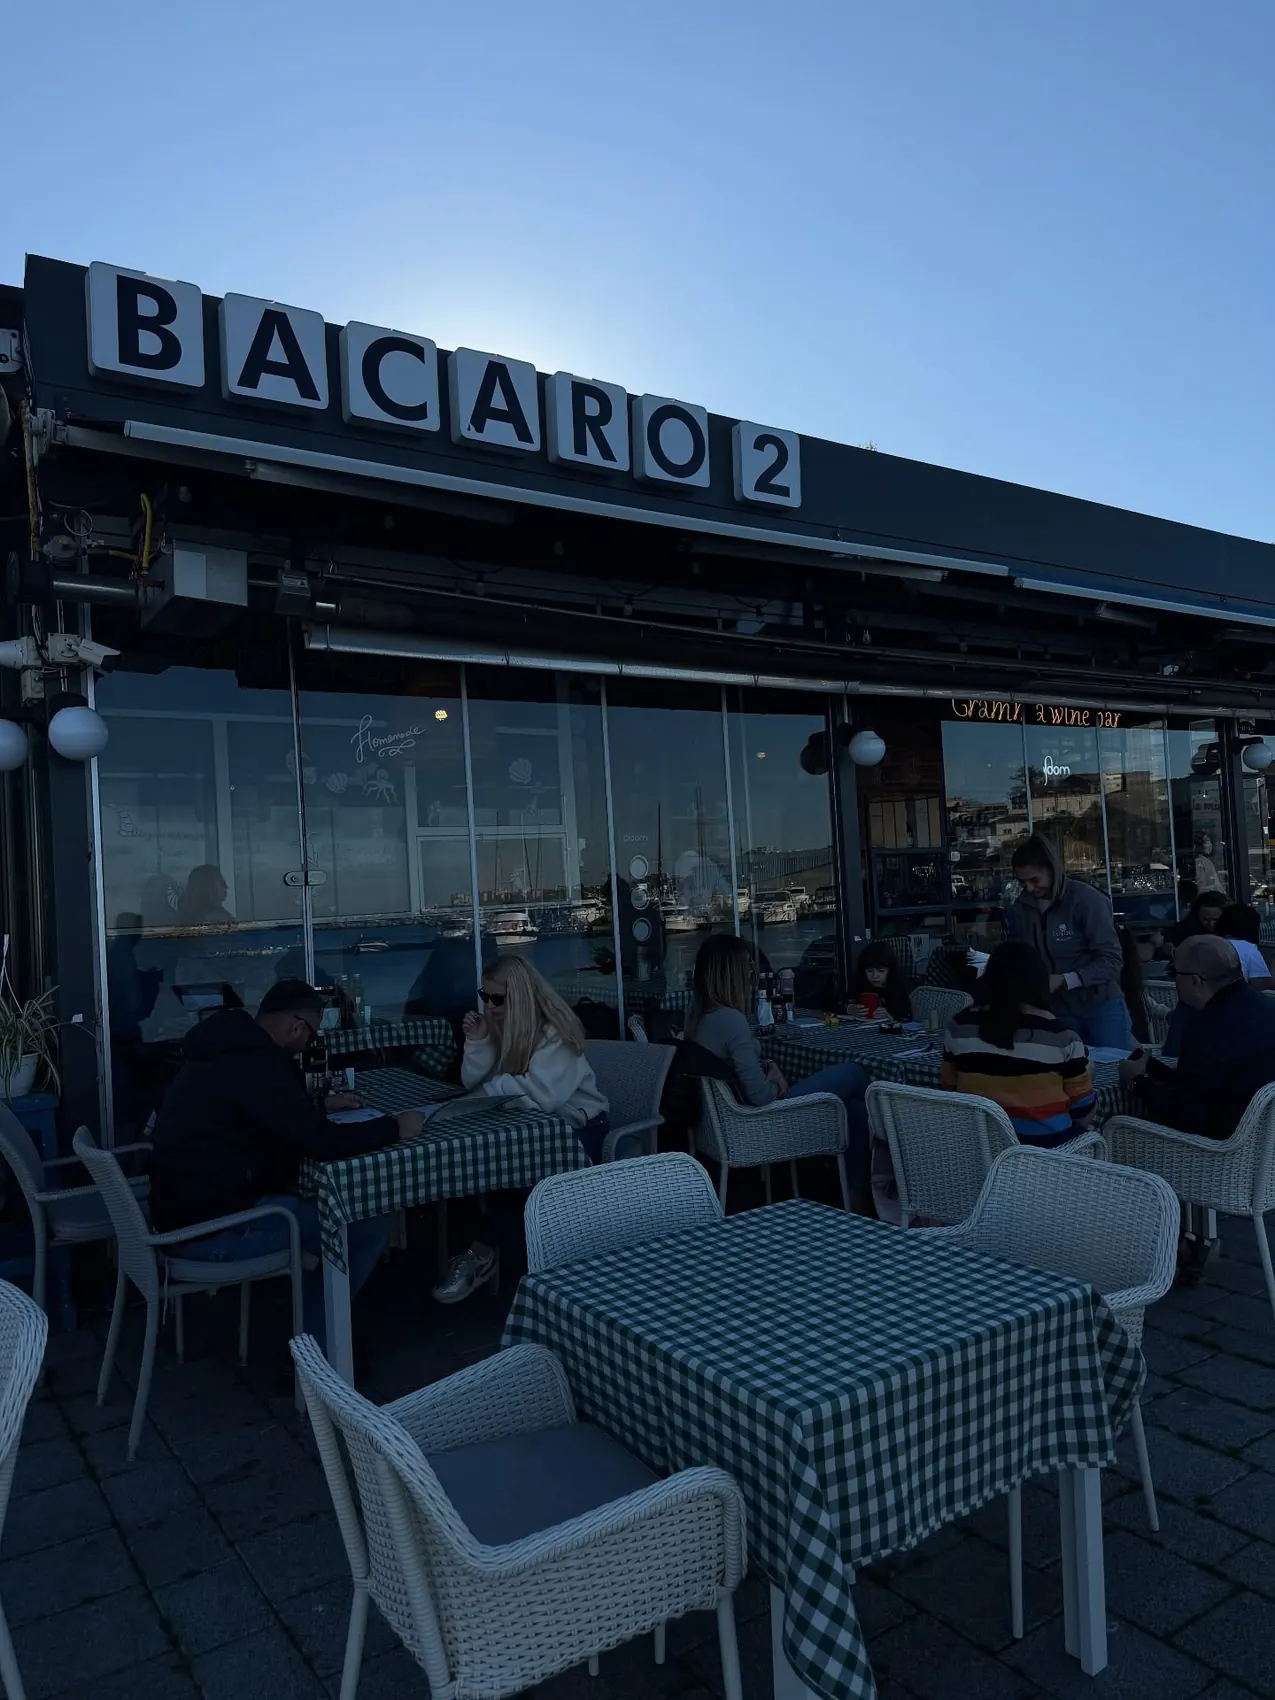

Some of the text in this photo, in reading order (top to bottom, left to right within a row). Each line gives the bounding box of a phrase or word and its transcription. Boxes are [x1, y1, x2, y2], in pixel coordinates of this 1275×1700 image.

[116, 274, 791, 498] BACARO 2
[350, 714, 427, 763] Homemade
